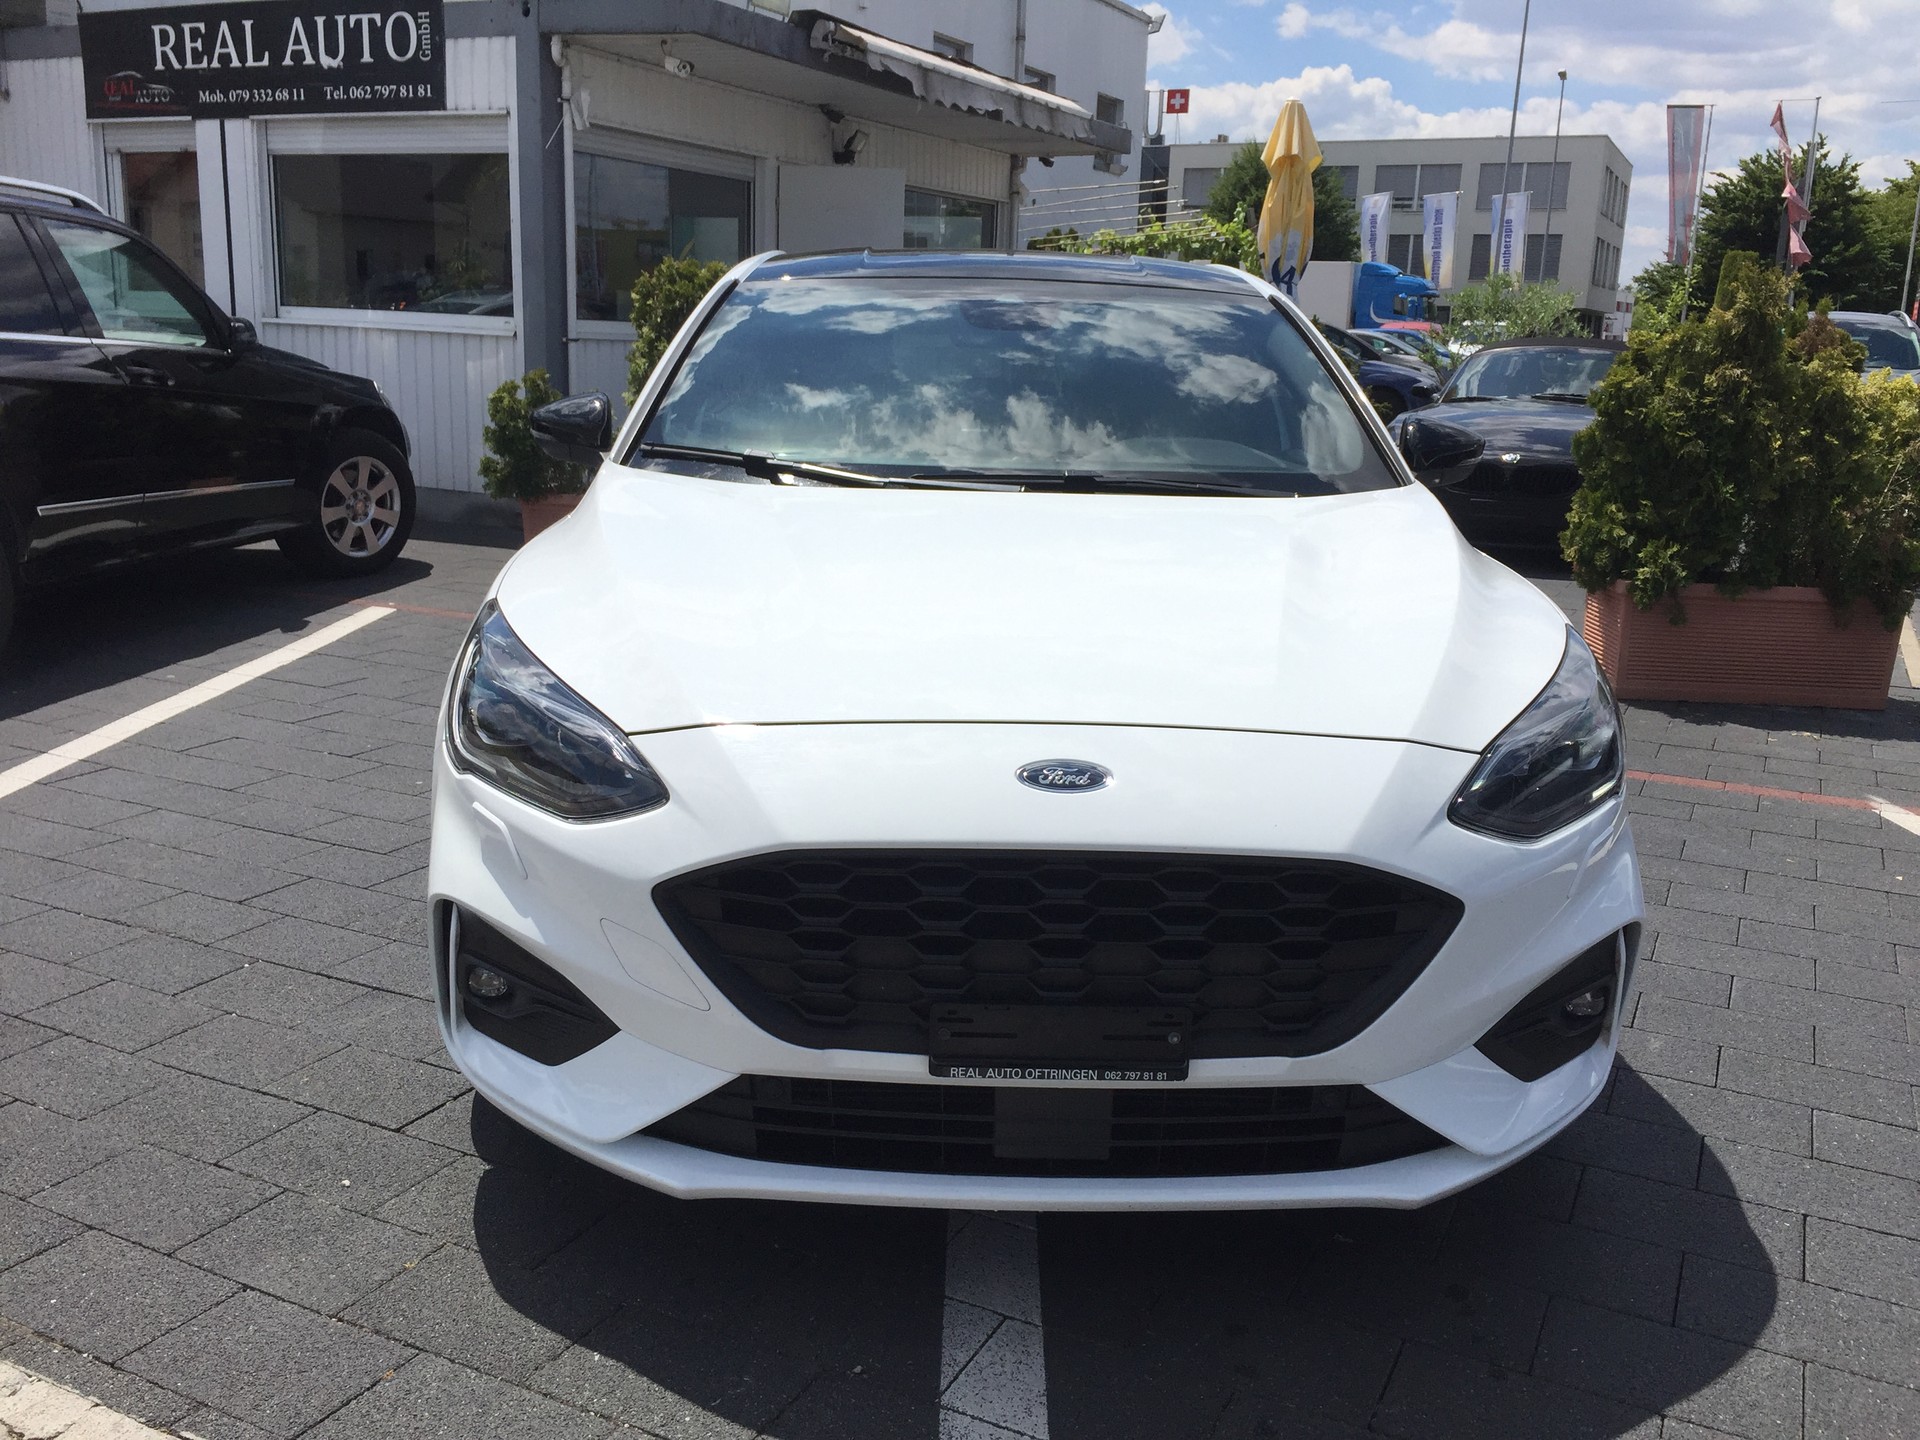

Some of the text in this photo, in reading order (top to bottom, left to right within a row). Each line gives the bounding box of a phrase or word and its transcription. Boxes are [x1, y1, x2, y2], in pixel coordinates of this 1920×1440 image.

[151, 11, 417, 71] REAL AUTO
[417, 10, 432, 61] GmbH
[135, 88, 171, 103] AUTO
[199, 88, 305, 103] Mob. 079 332 68 11
[324, 84, 432, 100] Tel. 062 797 81 81
[1038, 766, 1091, 785] Ford
[950, 1067, 1168, 1081] REAL AUTO OFTRINGEN 062 797 81 81
